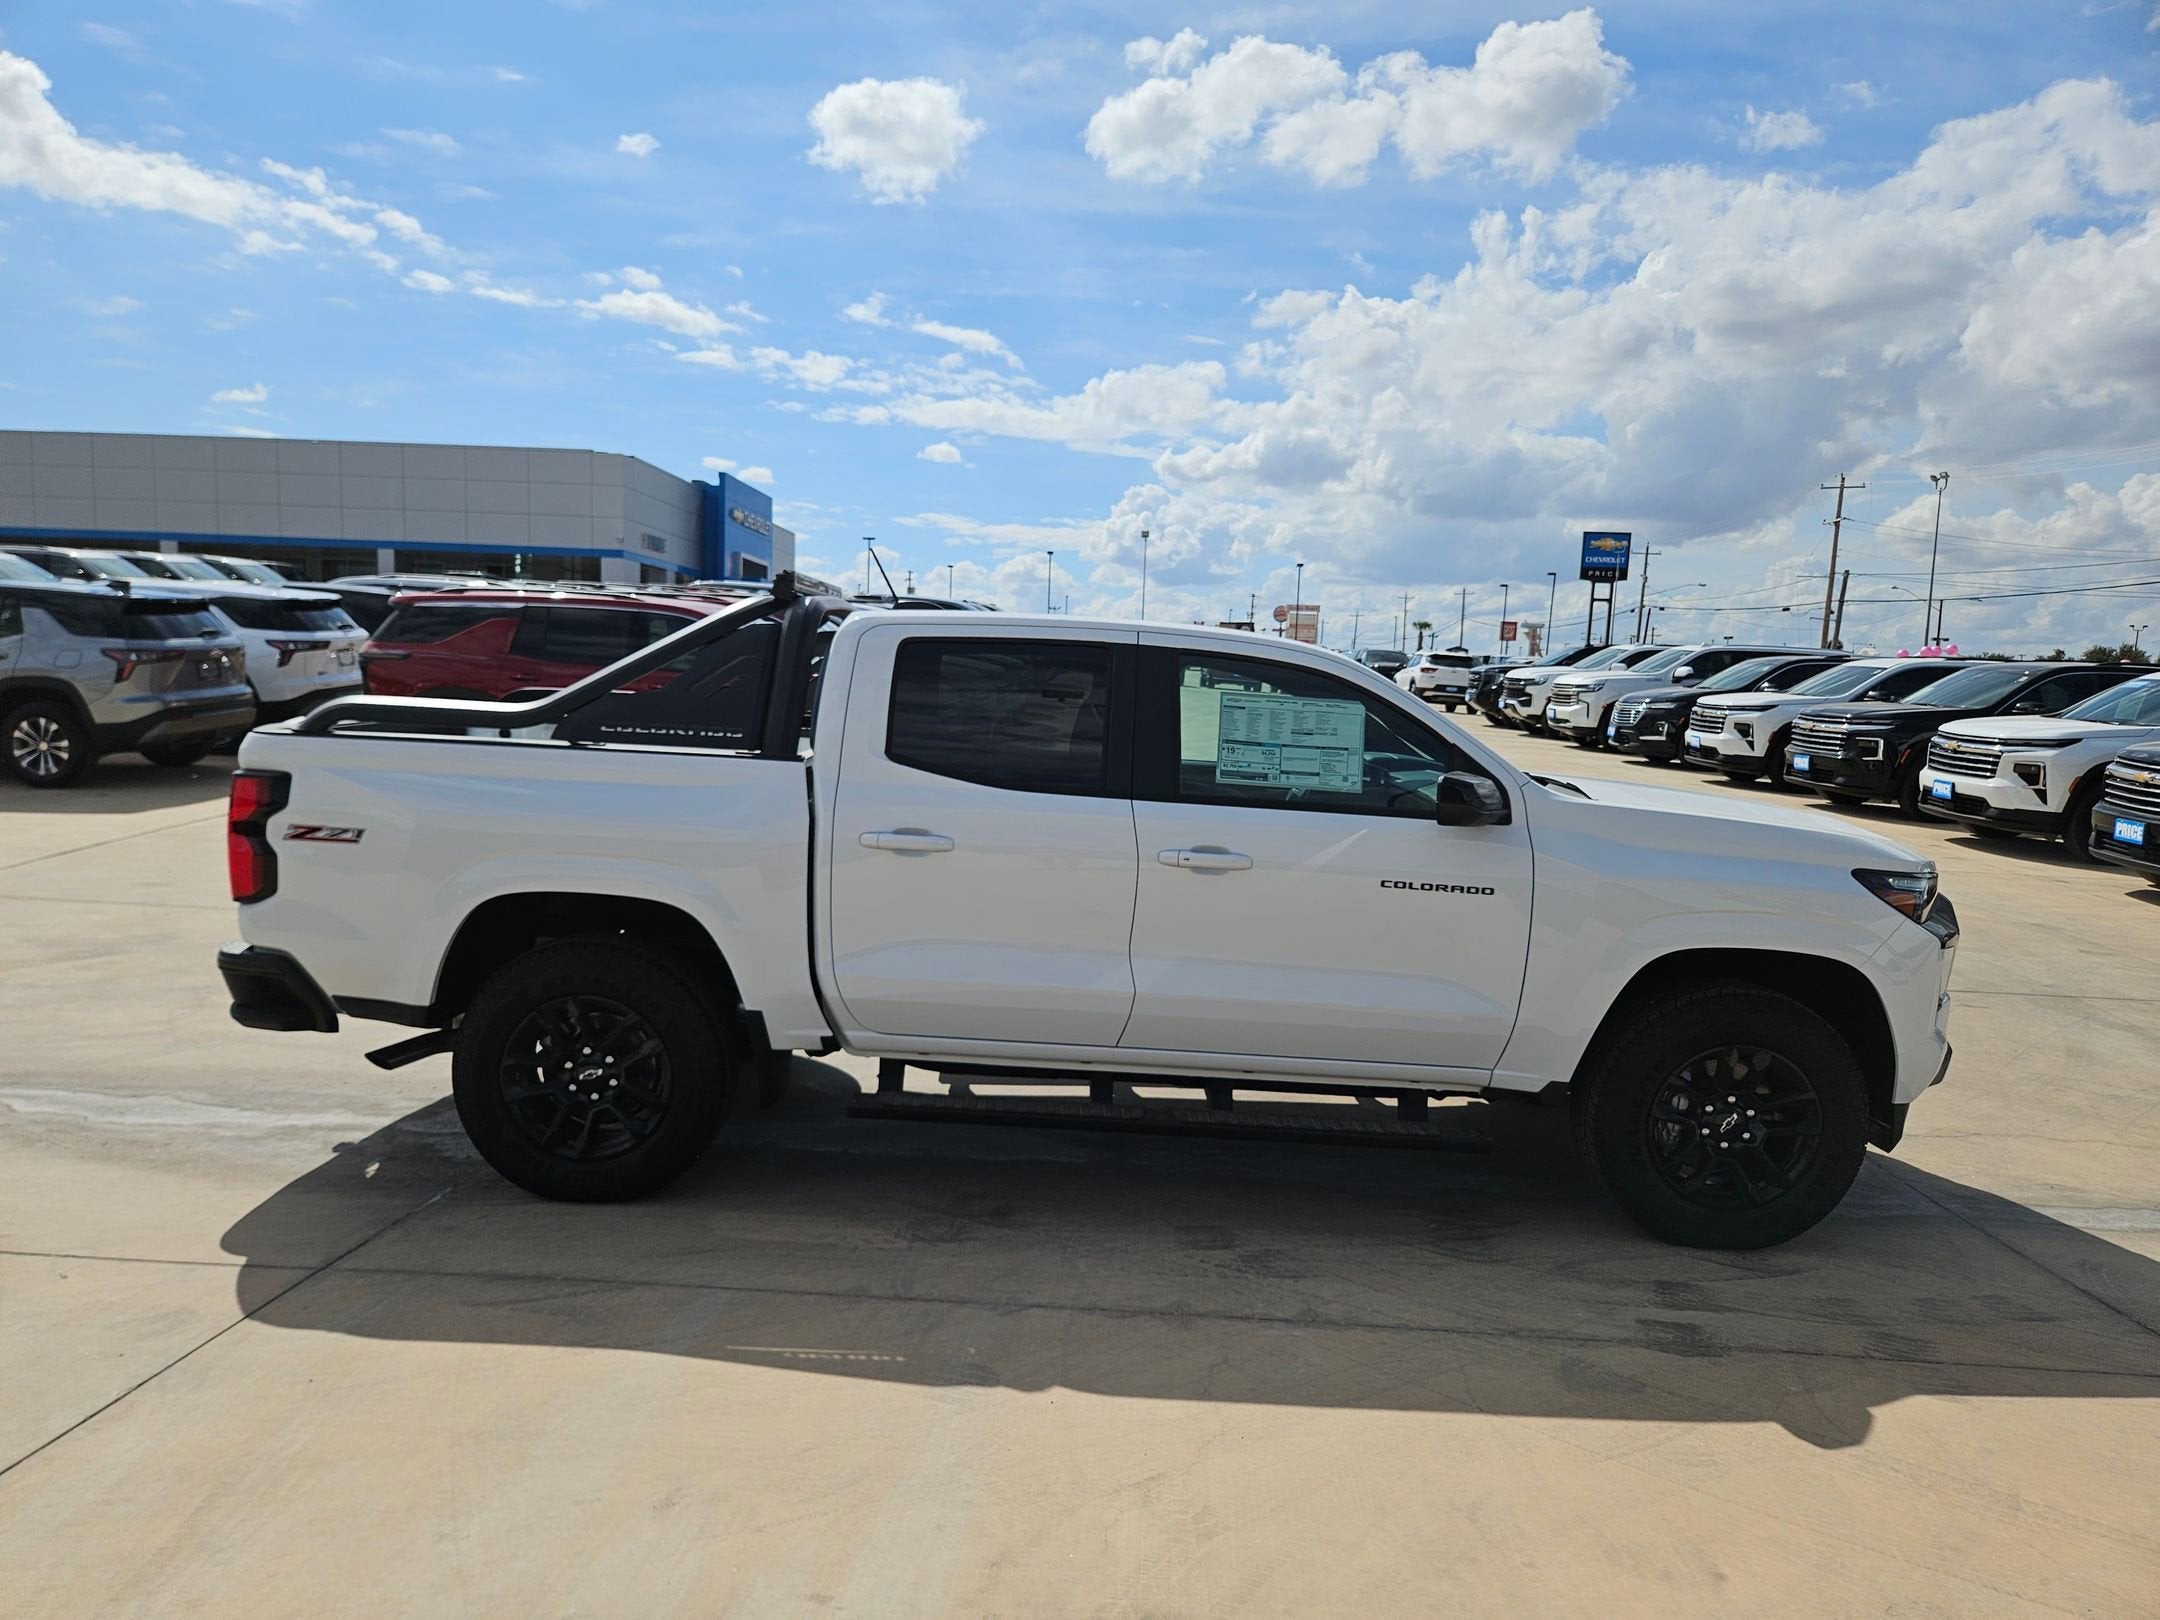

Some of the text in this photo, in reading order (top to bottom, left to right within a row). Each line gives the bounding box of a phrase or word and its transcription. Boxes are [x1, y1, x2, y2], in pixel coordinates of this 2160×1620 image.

[282, 824, 366, 844] Z71
[2115, 821, 2144, 842] PRICE
[1380, 880, 1495, 895] COLORADO
